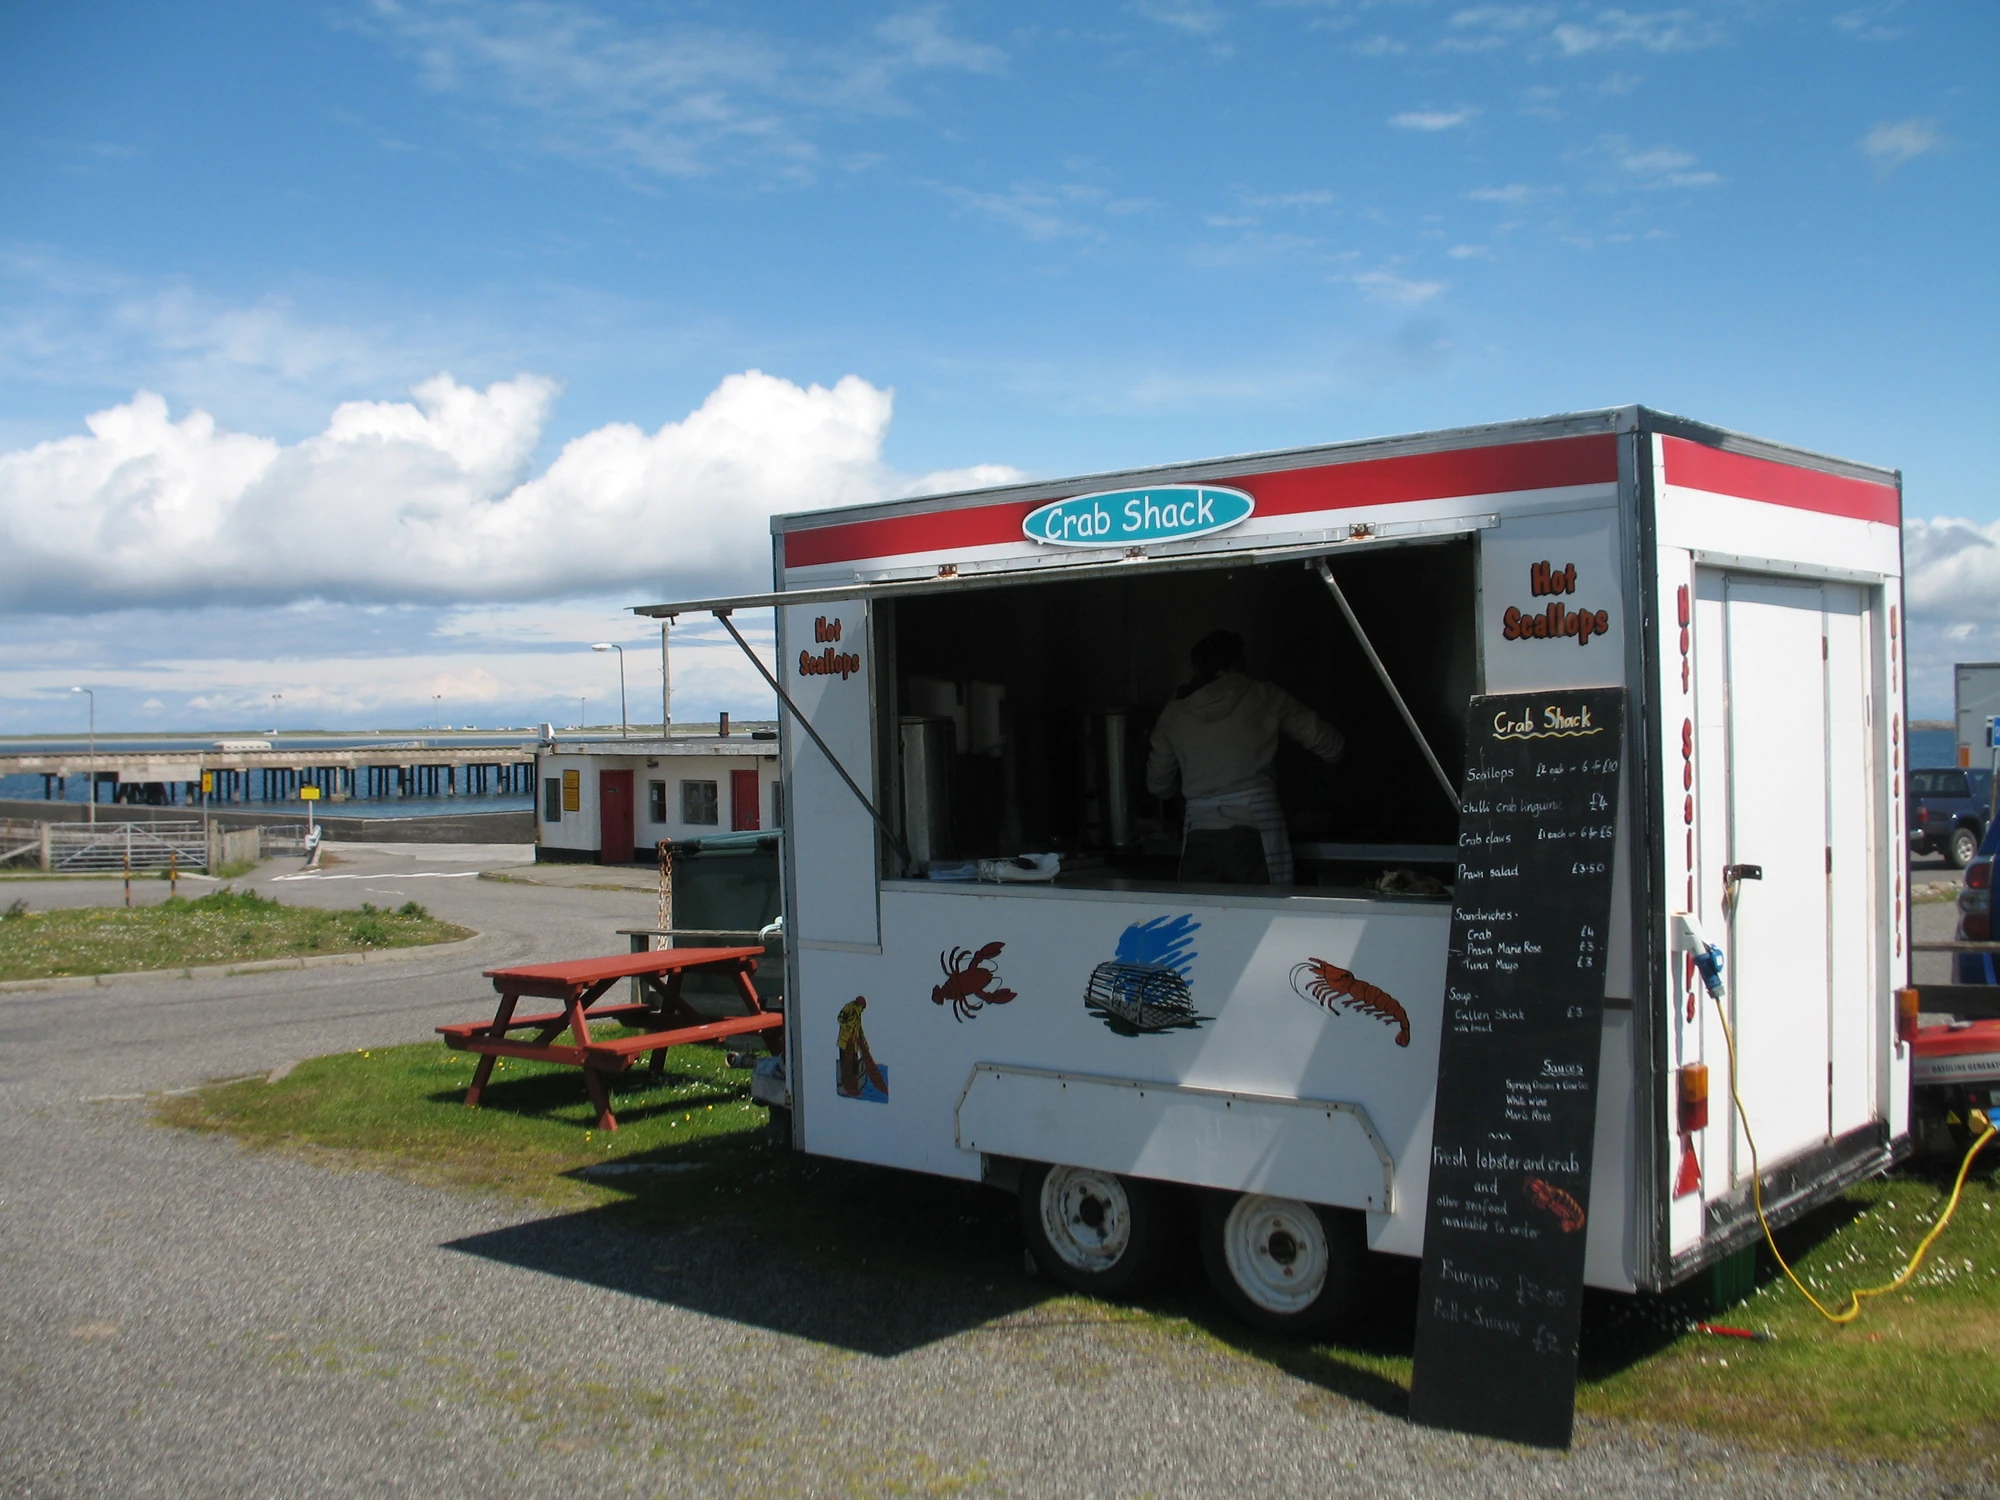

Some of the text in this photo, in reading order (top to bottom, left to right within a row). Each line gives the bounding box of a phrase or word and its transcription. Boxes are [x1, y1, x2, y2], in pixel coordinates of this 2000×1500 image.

[1045, 489, 1214, 539] Crab Shack
[1531, 560, 1577, 597] Hot
[815, 616, 841, 643] Hot
[1503, 602, 1609, 646] Scallops
[799, 647, 860, 681] Scallops
[1494, 705, 1592, 733] Crab Shack
[1467, 767, 1514, 782] Scallops
[1536, 762, 1546, 777] £2
[1602, 758, 1618, 773] £10
[1589, 793, 1608, 811] £4
[1677, 583, 1695, 1024] Hot Scallps
[1459, 833, 1481, 847] Crab
[1485, 831, 1511, 846] claws
[1538, 828, 1547, 840] £1
[1548, 828, 1566, 838] each
[1581, 828, 1587, 837] 6
[1600, 827, 1612, 837] £5
[1458, 864, 1483, 879] Prawn
[1490, 864, 1518, 876] salad
[1467, 925, 1595, 940] Crab £4
[1467, 941, 1594, 956] Prawn Marie Rose £3
[1463, 956, 1592, 974] Tuna Mayo £3
[1448, 987, 1471, 1005] Soup
[1455, 1007, 1583, 1021] Cullen Skink £3
[1542, 1060, 1584, 1074] Sauces
[1967, 1061, 2000, 1071] GENERAT
[1433, 1147, 1579, 1173] Fresh lobster and crab
[1474, 1177, 1498, 1195] and
